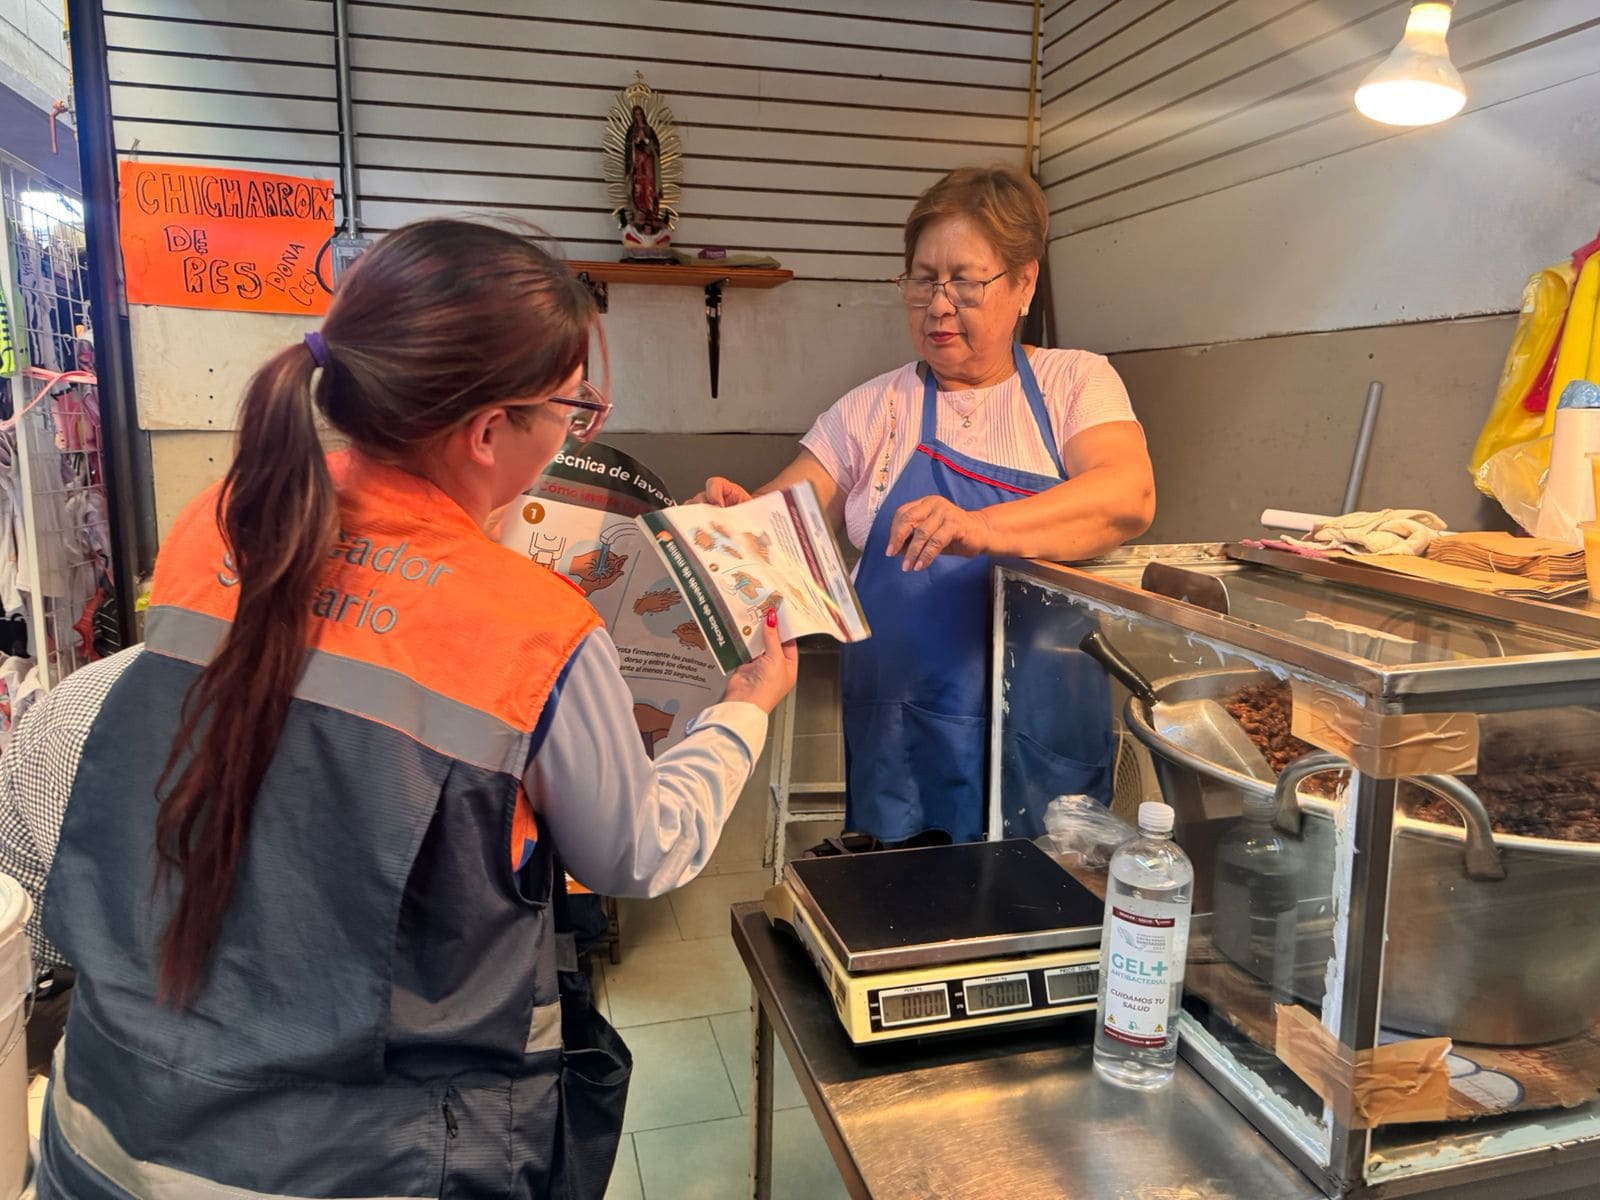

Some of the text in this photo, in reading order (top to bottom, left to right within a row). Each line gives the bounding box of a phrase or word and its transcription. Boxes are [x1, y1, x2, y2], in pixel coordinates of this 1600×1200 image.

[136, 170, 335, 220] CHICHARRON
[164, 224, 208, 256] DE
[184, 256, 263, 300] RES
[554, 450, 606, 474] écnica
[609, 466, 630, 481] de
[709, 615, 726, 647] Técnica
[624, 656, 642, 664] dorso
[632, 648, 670, 659] firmemente
[1110, 969, 1167, 985] ANTIBACTERIAL
[1110, 988, 1152, 1005] CUIDAMOS
[1123, 1001, 1151, 1012] SALUD
